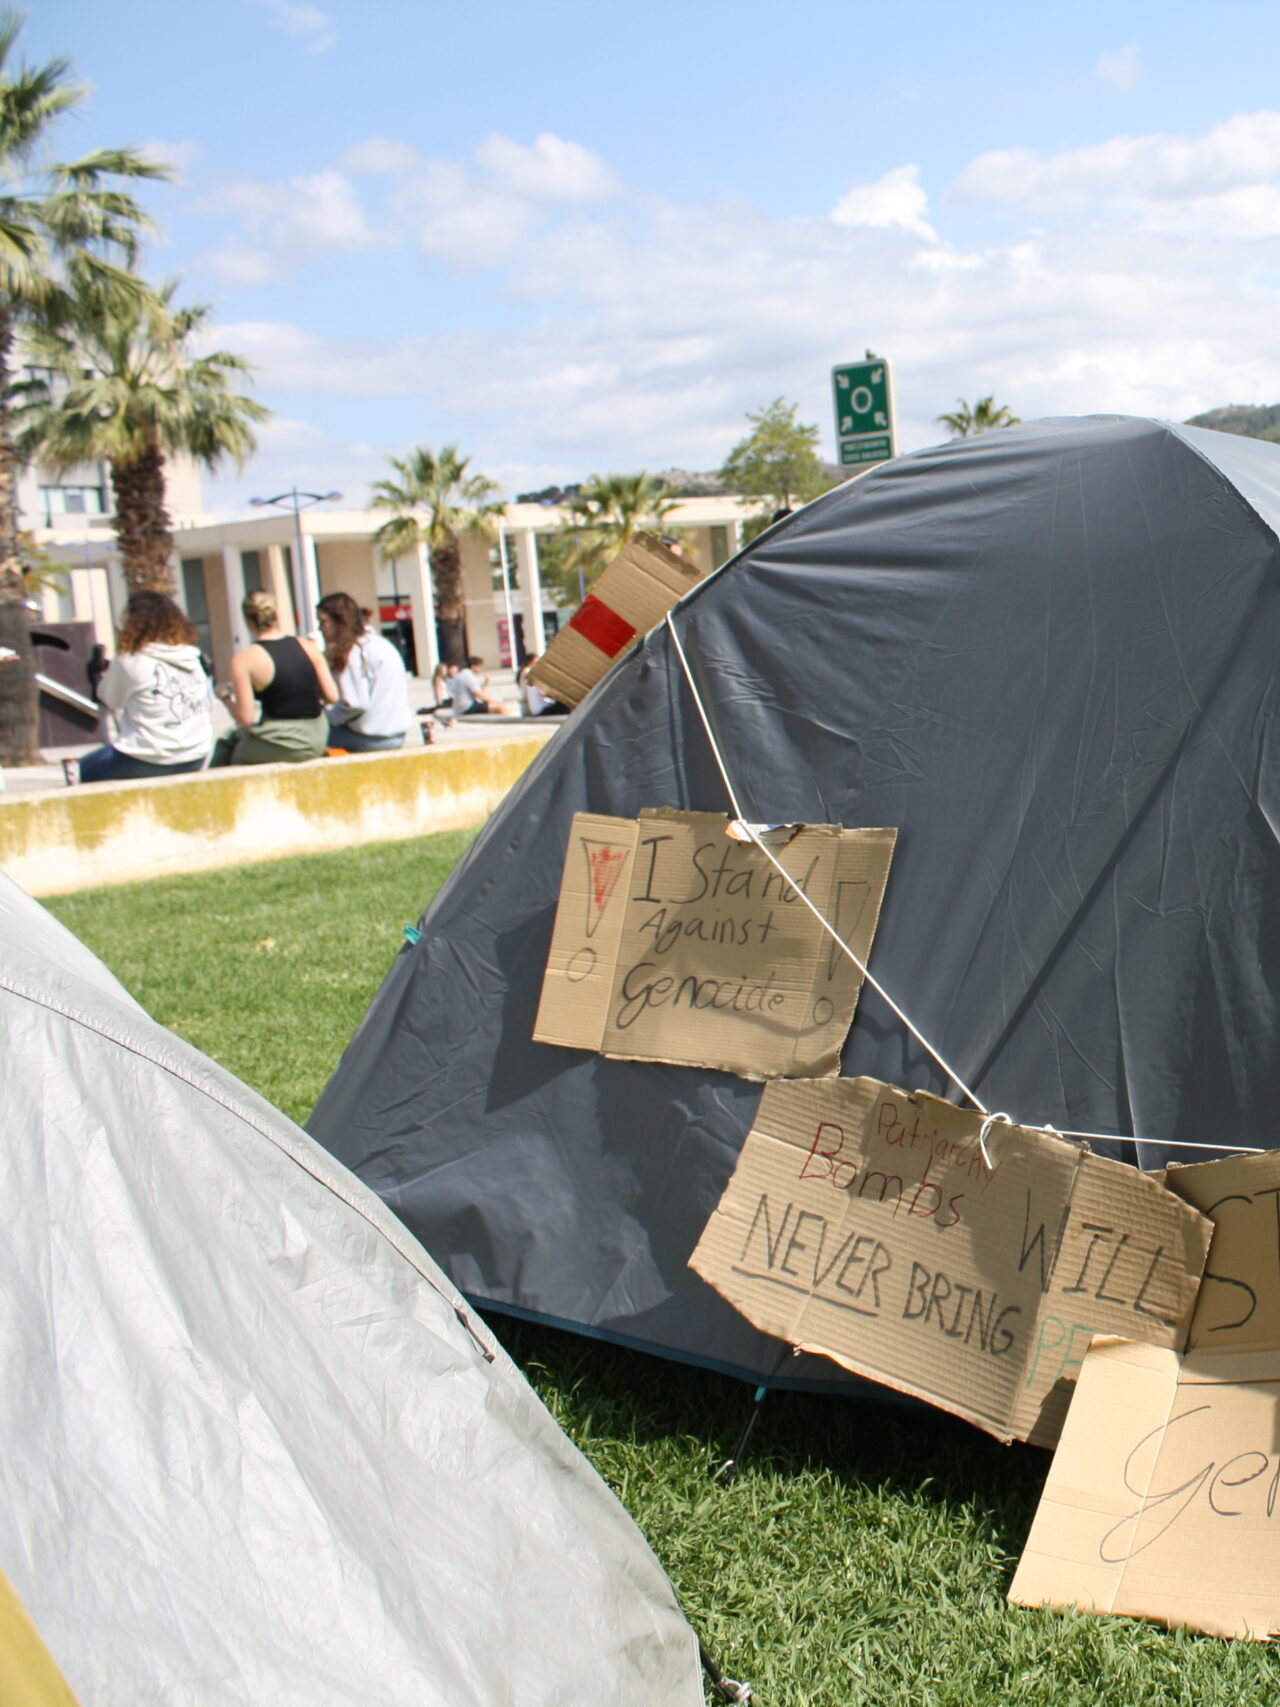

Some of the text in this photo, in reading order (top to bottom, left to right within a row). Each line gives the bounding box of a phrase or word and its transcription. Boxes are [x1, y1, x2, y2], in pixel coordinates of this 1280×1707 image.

[632, 835, 820, 904] I Stand
[638, 908, 779, 954] Against
[615, 962, 785, 1030] Genocide
[799, 1122, 1178, 1327] Bombs WILL
[739, 1193, 893, 1308] NEVER
[902, 1261, 1023, 1357] BRING
